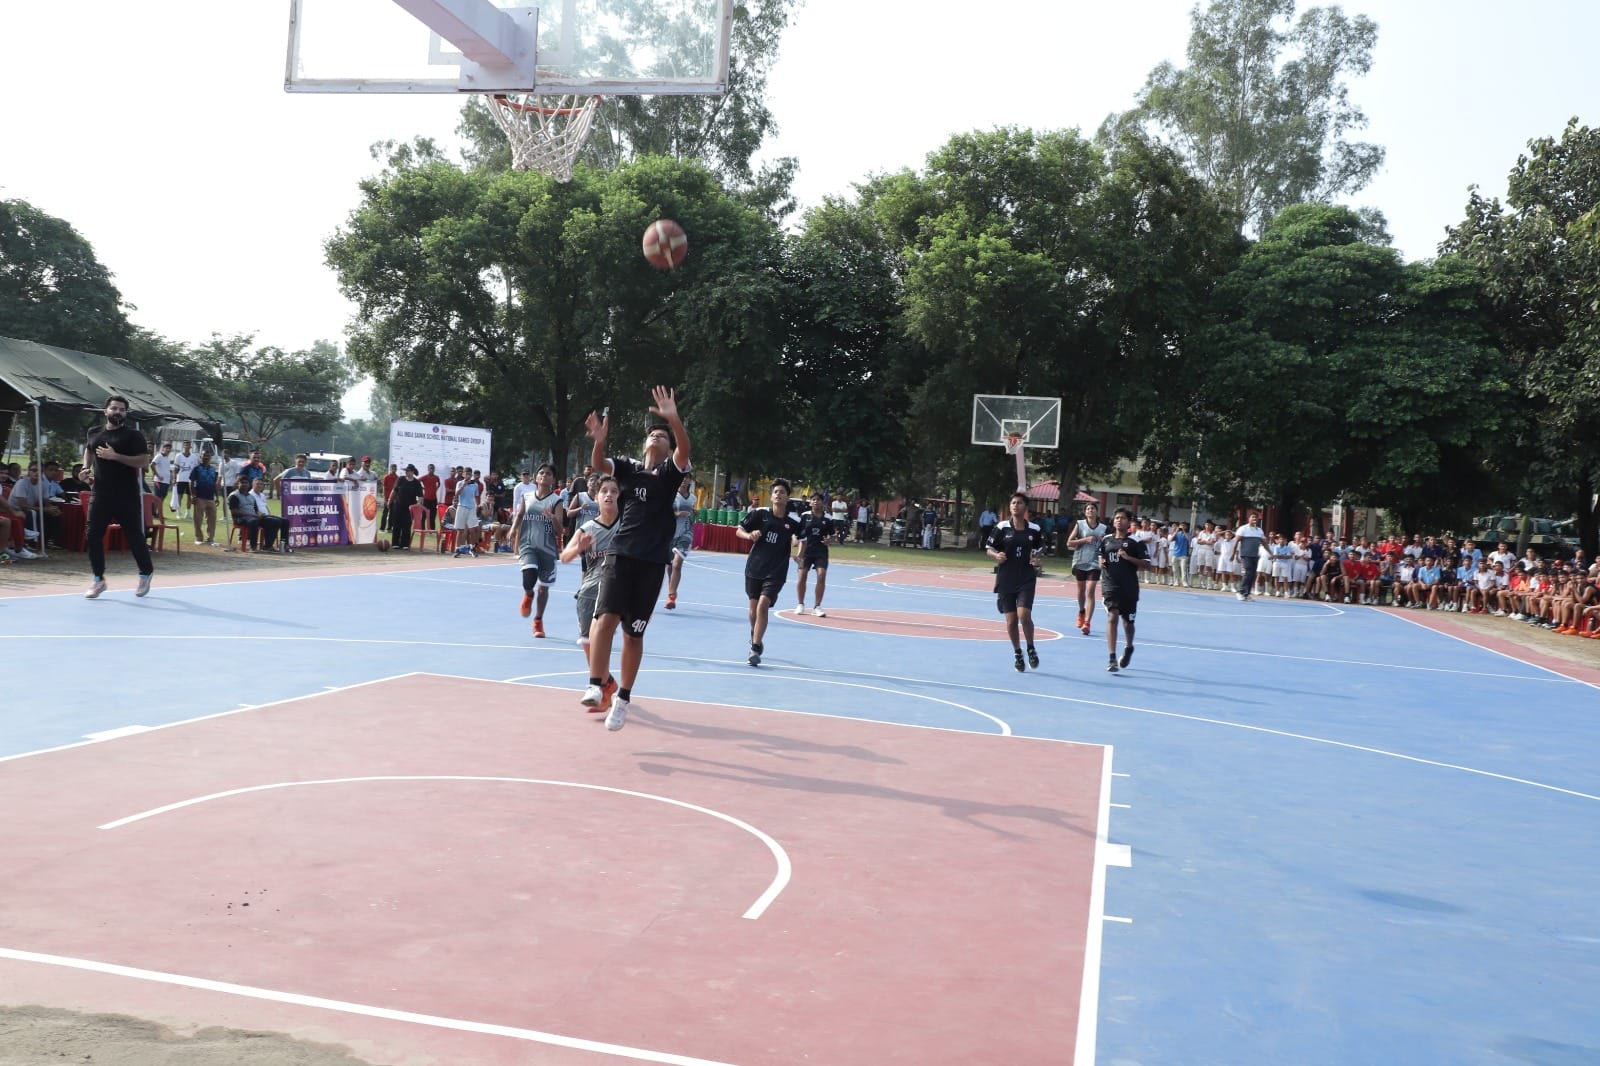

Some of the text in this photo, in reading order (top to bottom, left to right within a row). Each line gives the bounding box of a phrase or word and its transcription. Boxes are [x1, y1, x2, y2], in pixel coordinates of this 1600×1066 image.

[426, 433, 440, 441] SCHOOL
[287, 504, 340, 515] BASKETBALL
[766, 531, 779, 544] 98
